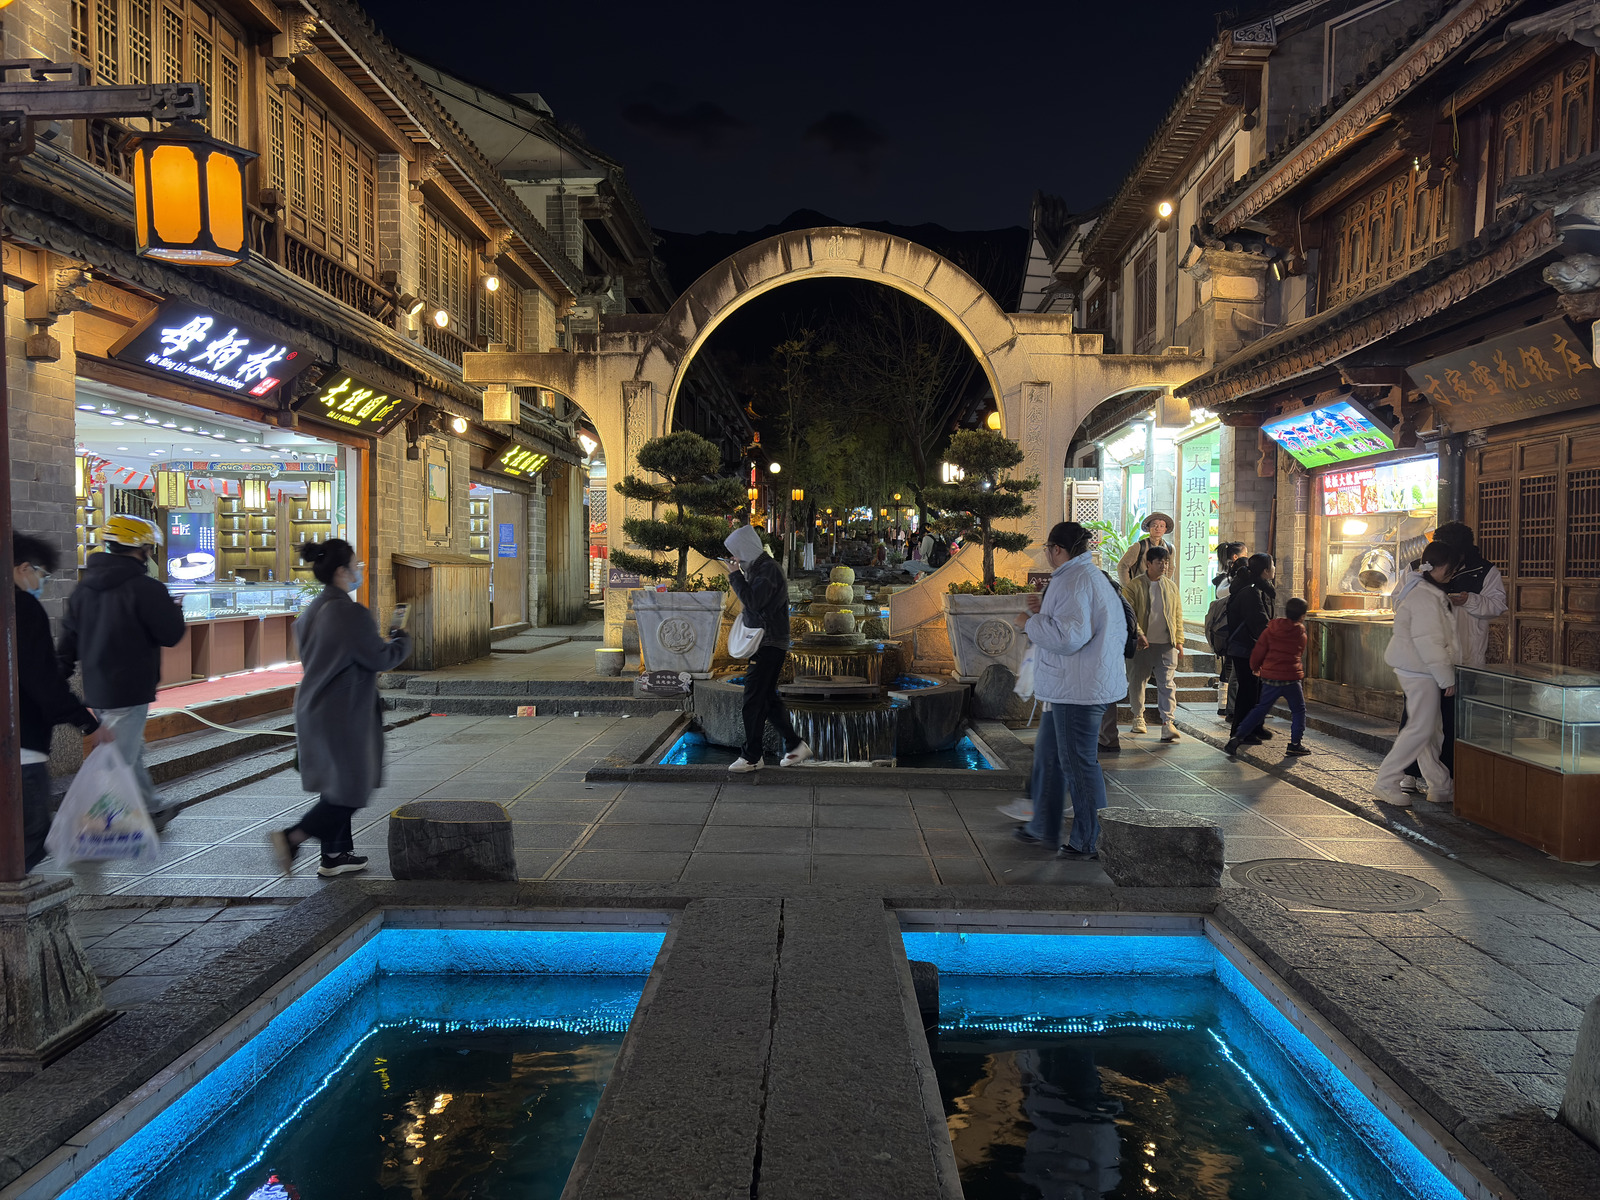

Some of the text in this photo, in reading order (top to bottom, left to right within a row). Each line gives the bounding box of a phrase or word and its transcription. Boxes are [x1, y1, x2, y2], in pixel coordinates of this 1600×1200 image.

[145, 353, 159, 365] Mu
[157, 356, 173, 371] Bing
[176, 362, 187, 374] Lin
[186, 365, 217, 382] Handmade
[216, 374, 246, 390] Workshop
[1494, 394, 1548, 416] Snowflake
[1547, 387, 1581, 404] Silver
[172, 515, 190, 535] 工匠
[1184, 454, 1207, 605] 大理热销护手霜
